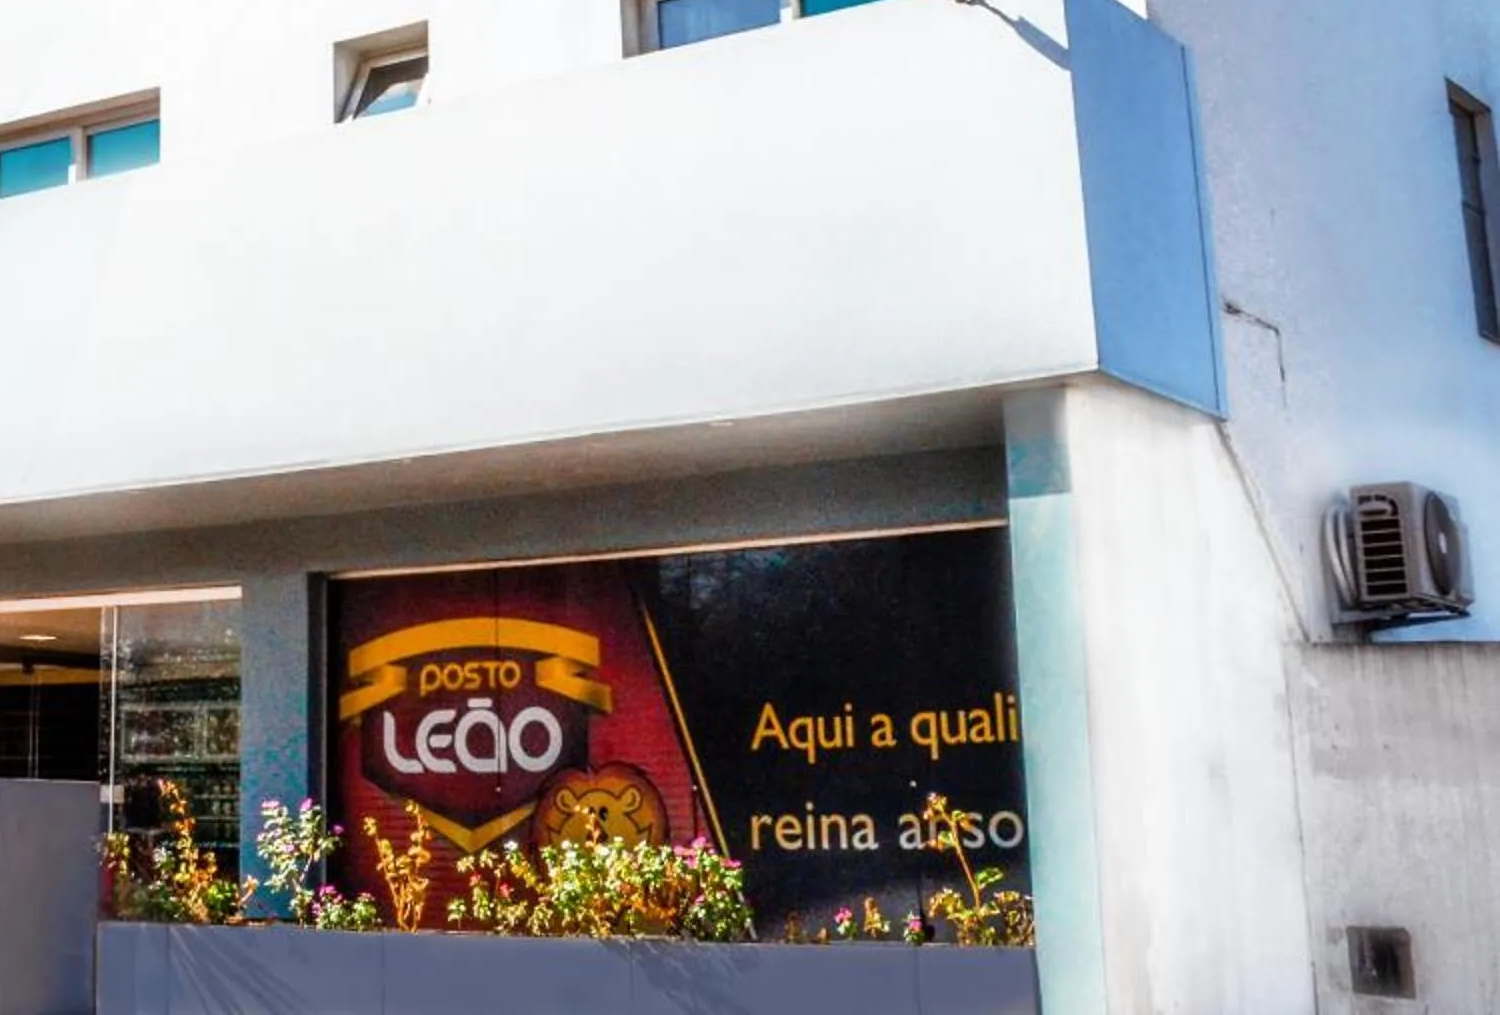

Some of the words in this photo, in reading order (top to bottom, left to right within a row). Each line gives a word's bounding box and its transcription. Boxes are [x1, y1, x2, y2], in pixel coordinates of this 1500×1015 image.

[419, 660, 521, 697] POSTO
[382, 697, 563, 774] LEÃO
[750, 701, 855, 765] Aqui
[869, 712, 897, 747] a
[909, 691, 1020, 761] quali
[750, 801, 879, 851] reina
